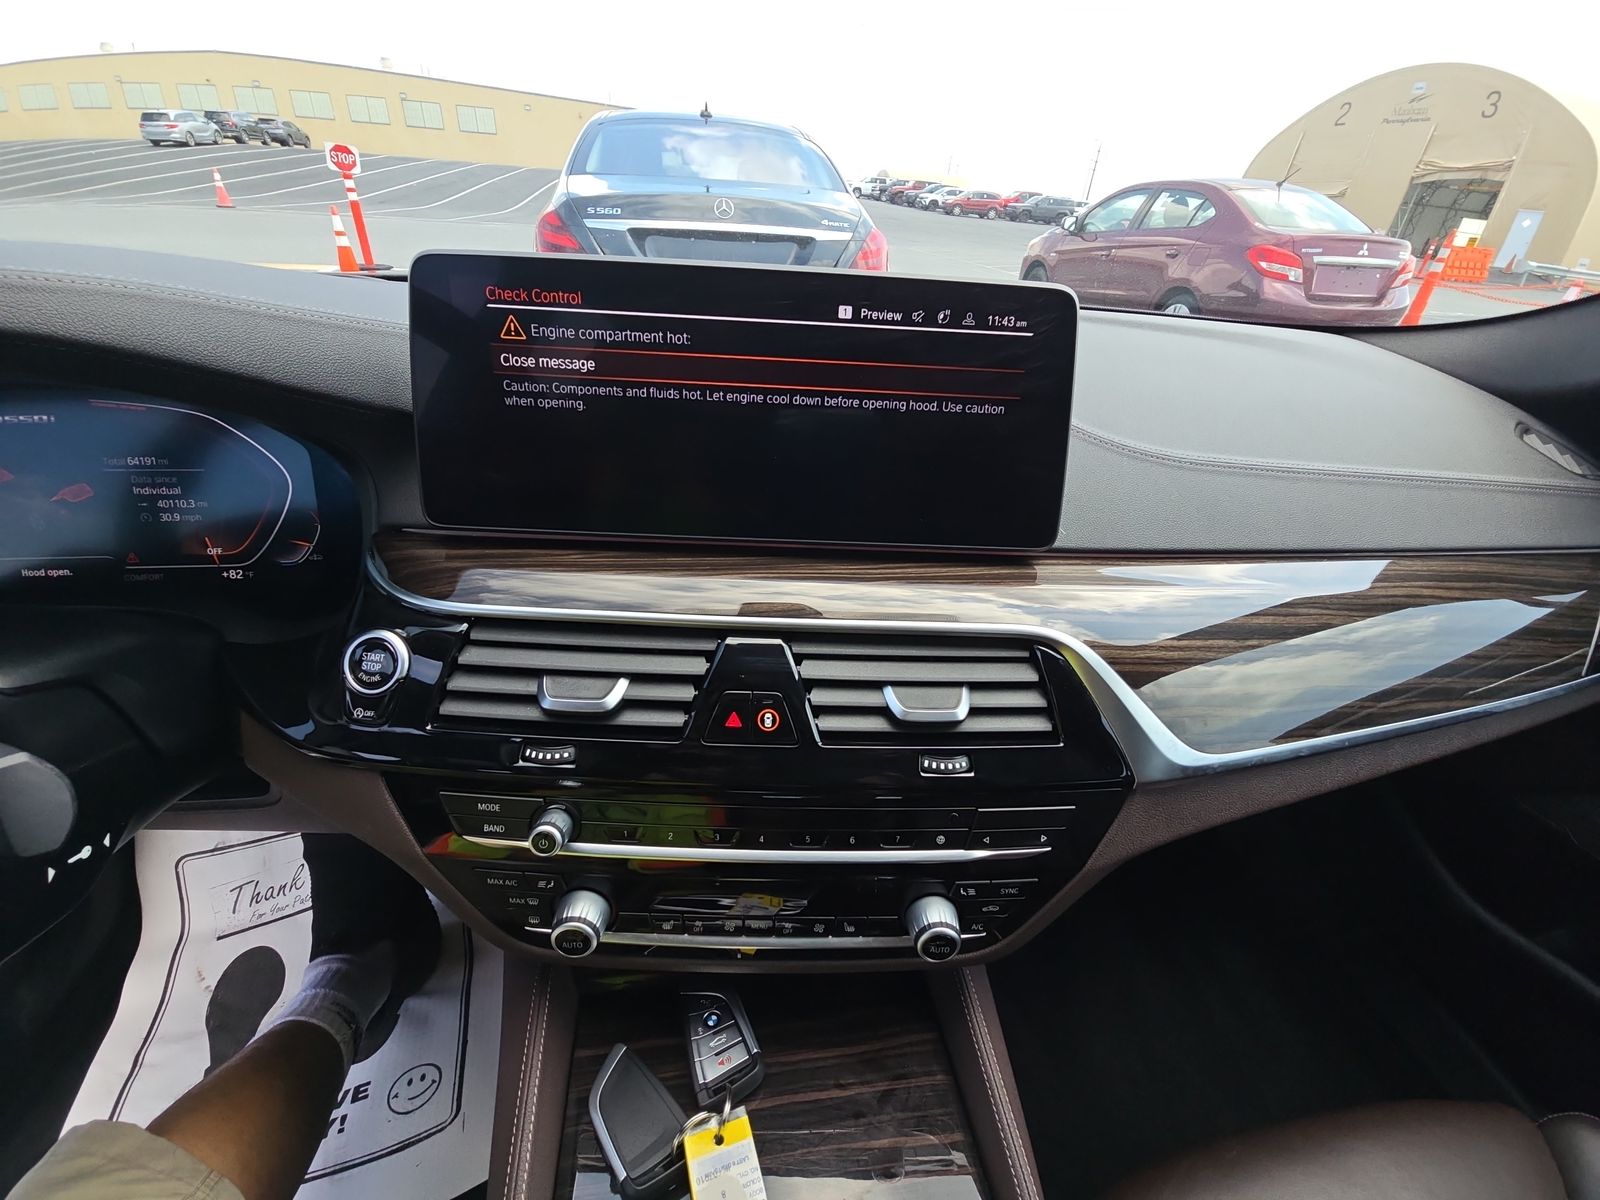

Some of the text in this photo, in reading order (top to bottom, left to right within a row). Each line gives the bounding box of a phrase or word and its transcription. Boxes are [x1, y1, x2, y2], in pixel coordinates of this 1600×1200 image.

[1481, 90, 1501, 118] 3
[1334, 102, 1352, 126] 2
[330, 151, 355, 165] STOP
[596, 207, 622, 215] 560
[485, 286, 582, 305] Check Control
[860, 308, 903, 321] Preview
[986, 315, 1027, 328] 11:43 am
[531, 323, 691, 345] Engine compartment hot:
[500, 353, 596, 373] Close message
[503, 380, 1005, 415] Caution: Components and fluids hot. Let engine cool down before opening hood. Use caution
[504, 395, 586, 412] when opening.
[127, 456, 156, 466] 64191
[131, 474, 152, 484] Data
[133, 486, 182, 495] Individual
[157, 499, 196, 508] 40110.3
[160, 513, 202, 523] 30.9 mph
[207, 547, 223, 555] OFF
[21, 568, 74, 578] Hood open.
[221, 569, 244, 579] +82
[362, 652, 385, 662] START
[362, 661, 382, 671] STOP
[358, 672, 382, 683] ENGINE
[477, 803, 501, 812] MODE
[483, 824, 505, 833] BAND
[668, 833, 673, 841] 2
[714, 833, 720, 841] 3
[759, 835, 764, 843] 4
[805, 835, 811, 843] 5
[850, 836, 855, 844] 6
[895, 835, 900, 843] 7
[487, 878, 503, 886] MAX
[229, 862, 305, 915] Thank
[1000, 887, 1019, 895] SYNC
[509, 897, 525, 905] MAX
[249, 909, 266, 922] For
[269, 902, 289, 916] Your
[971, 923, 984, 931] A/C
